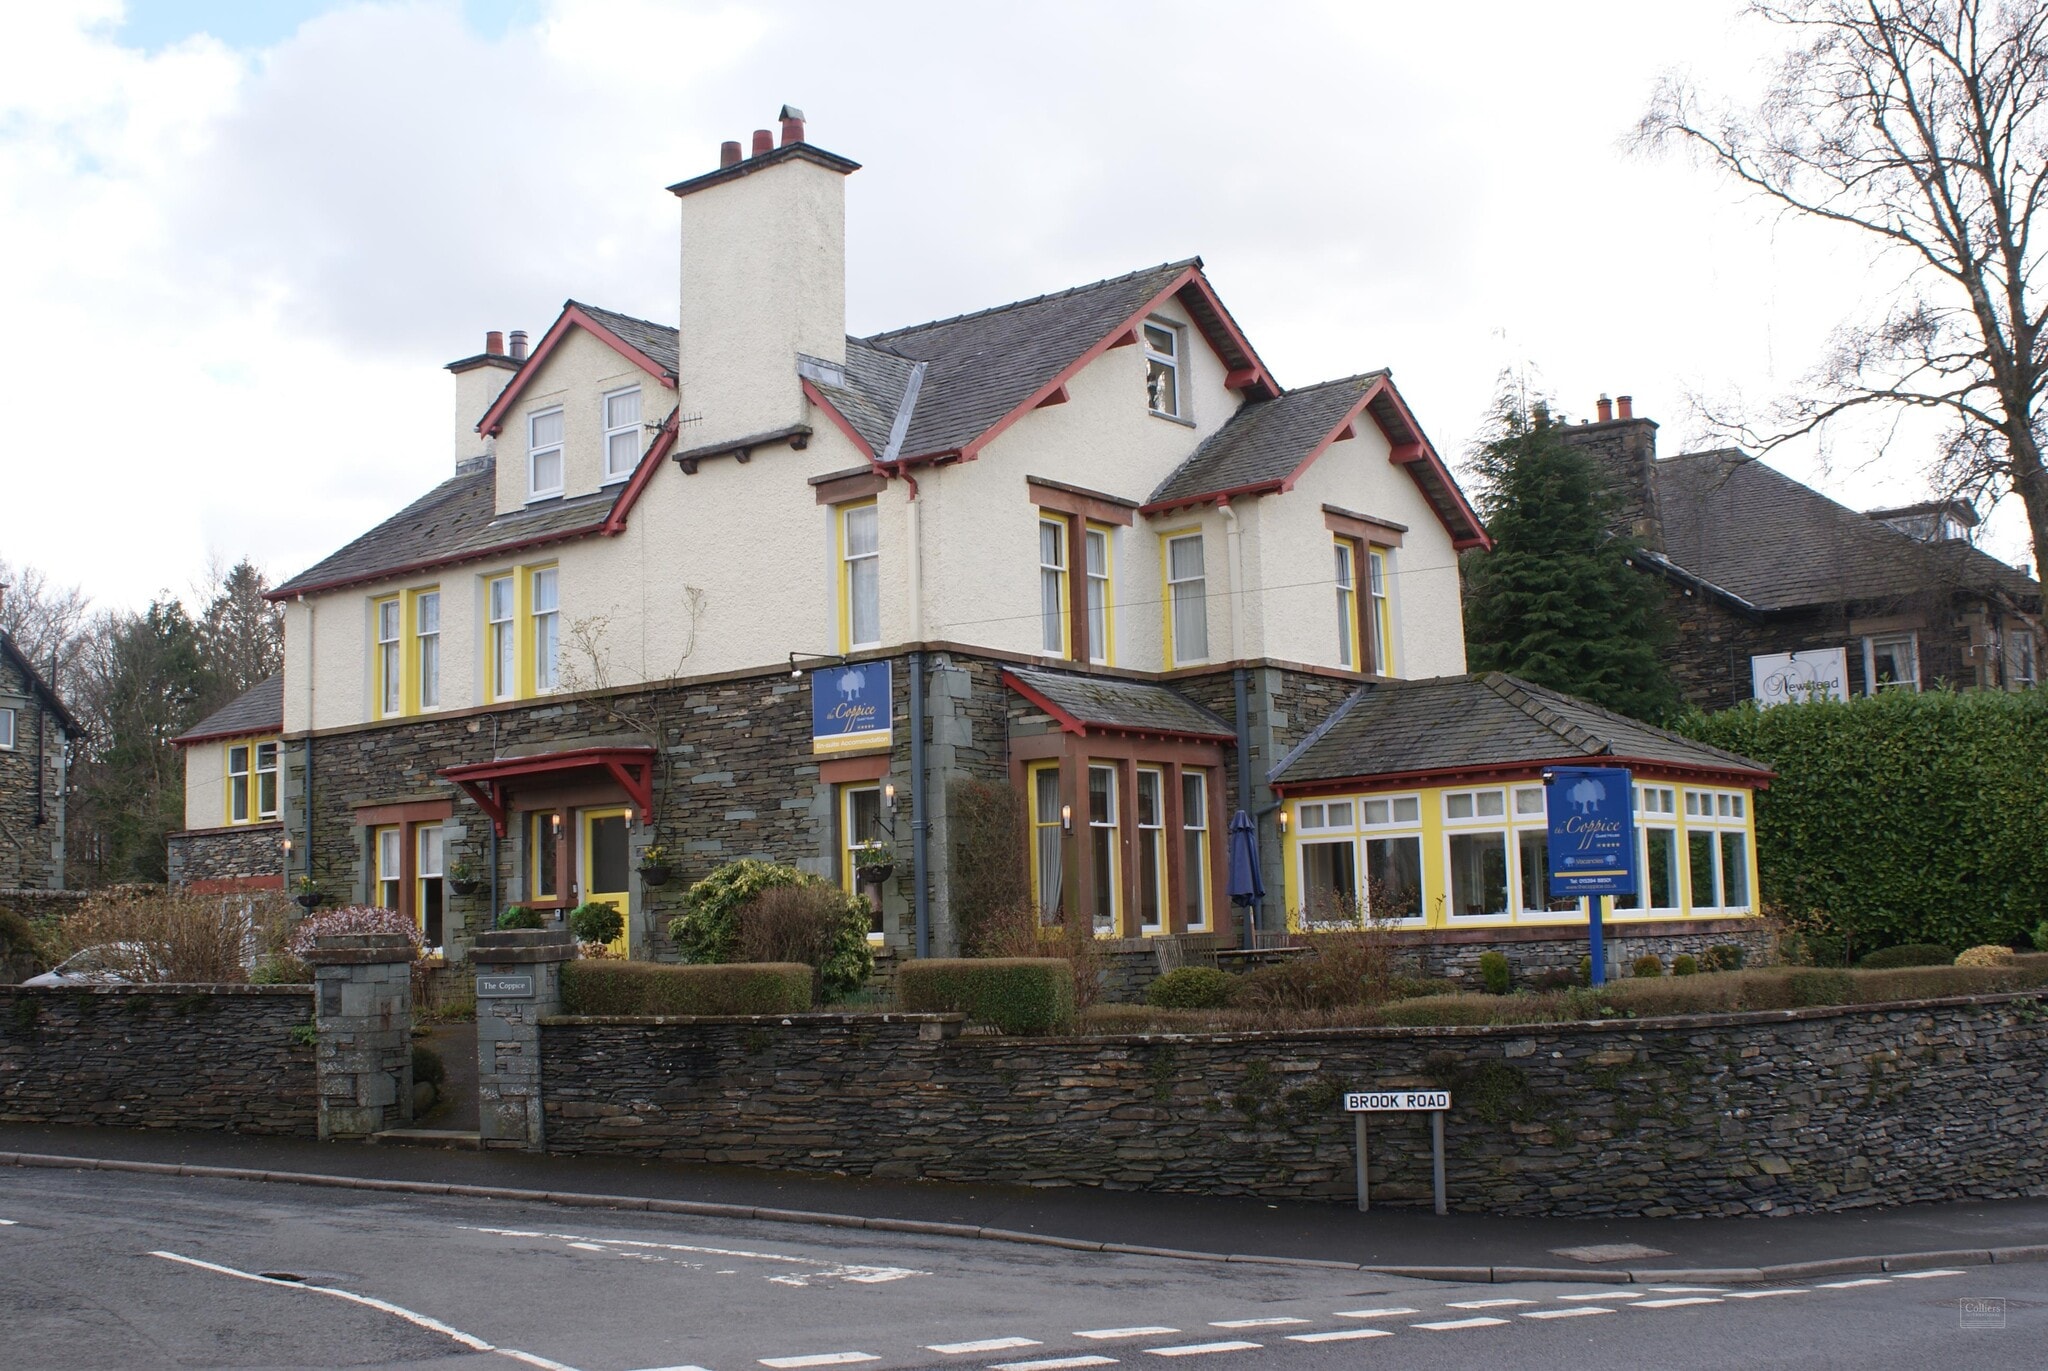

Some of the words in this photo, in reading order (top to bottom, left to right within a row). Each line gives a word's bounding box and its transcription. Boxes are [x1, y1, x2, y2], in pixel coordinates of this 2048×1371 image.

[835, 702, 877, 733] Coppice
[841, 736, 889, 746] Accommodation
[1566, 815, 1622, 850] Coppice
[484, 982, 497, 990] The
[499, 981, 526, 991] Coppice
[1350, 1095, 1400, 1108] BROOK
[1407, 1094, 1446, 1108] ROAD
